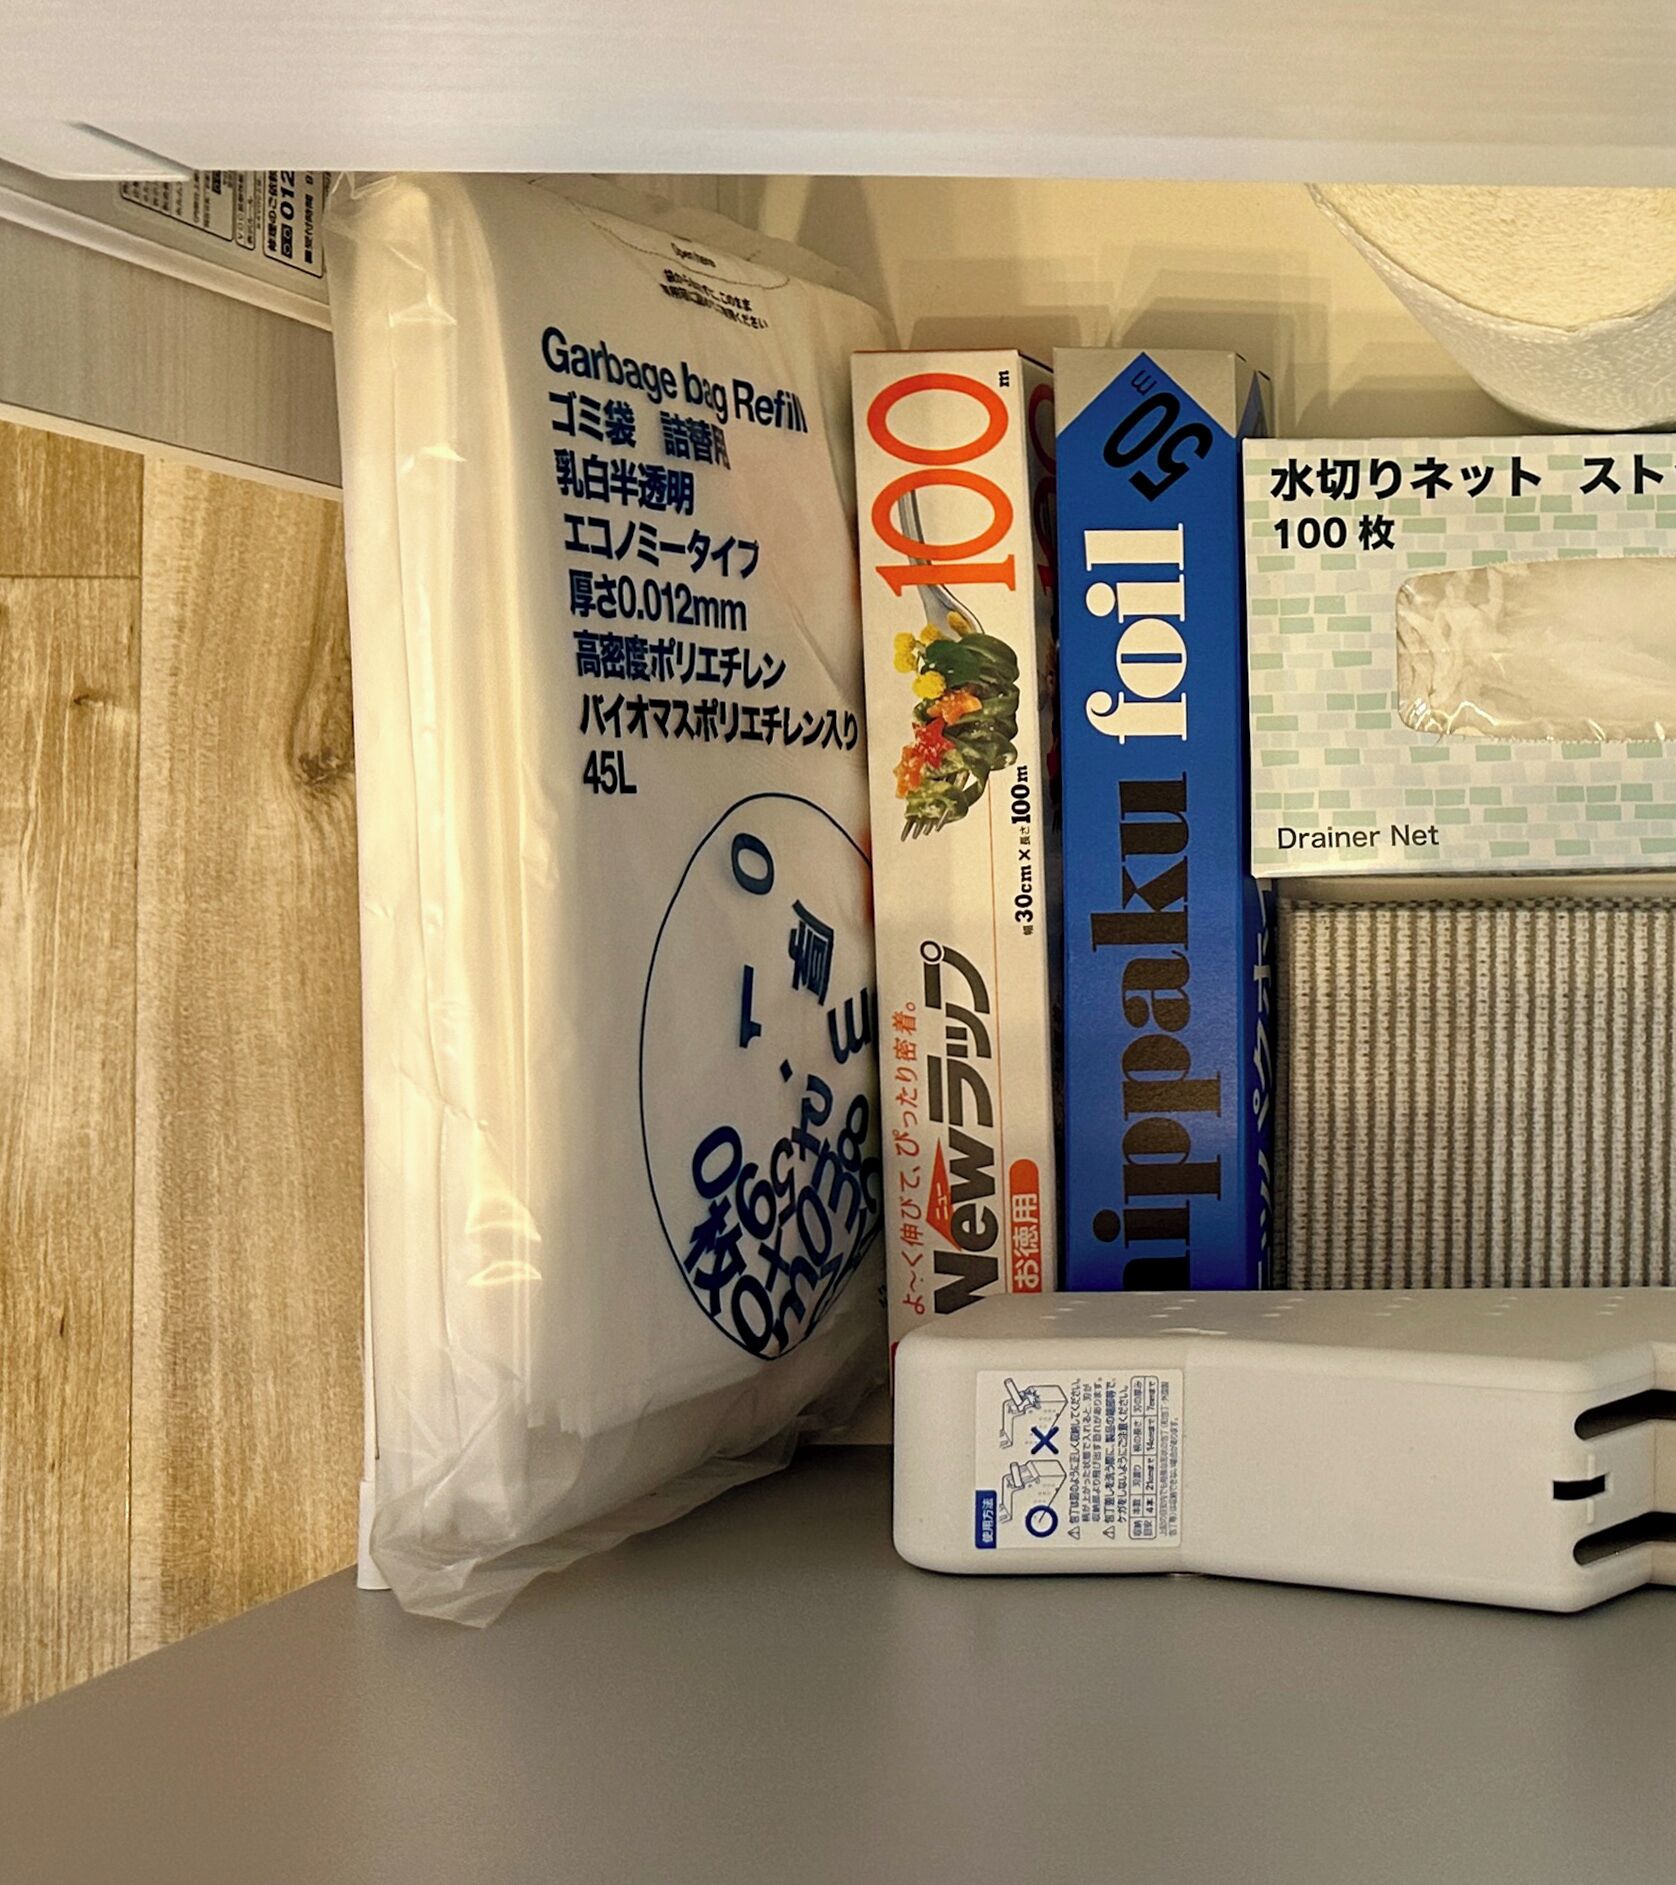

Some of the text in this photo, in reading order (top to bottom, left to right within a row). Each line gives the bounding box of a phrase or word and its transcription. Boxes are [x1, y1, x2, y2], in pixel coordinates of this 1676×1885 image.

[541, 325, 808, 434] Garbage bag Refill
[548, 390, 731, 471] ゴミ袋 詰替用
[553, 448, 694, 516] 乳白半透明
[1269, 455, 1542, 501] 水切りネット
[563, 513, 760, 579] エコノミータイプ
[568, 568, 747, 632] 厚さ0.012mm
[572, 629, 787, 690] 高密度ポリエチレン
[1083, 523, 1188, 745] foil
[579, 693, 858, 751] バイオマスポリエチレン入り
[582, 750, 638, 795] 45L
[1278, 823, 1440, 850] Drainer Net
[1011, 1193, 1041, 1289] お徳用
[982, 1497, 994, 1543] 使用方法
